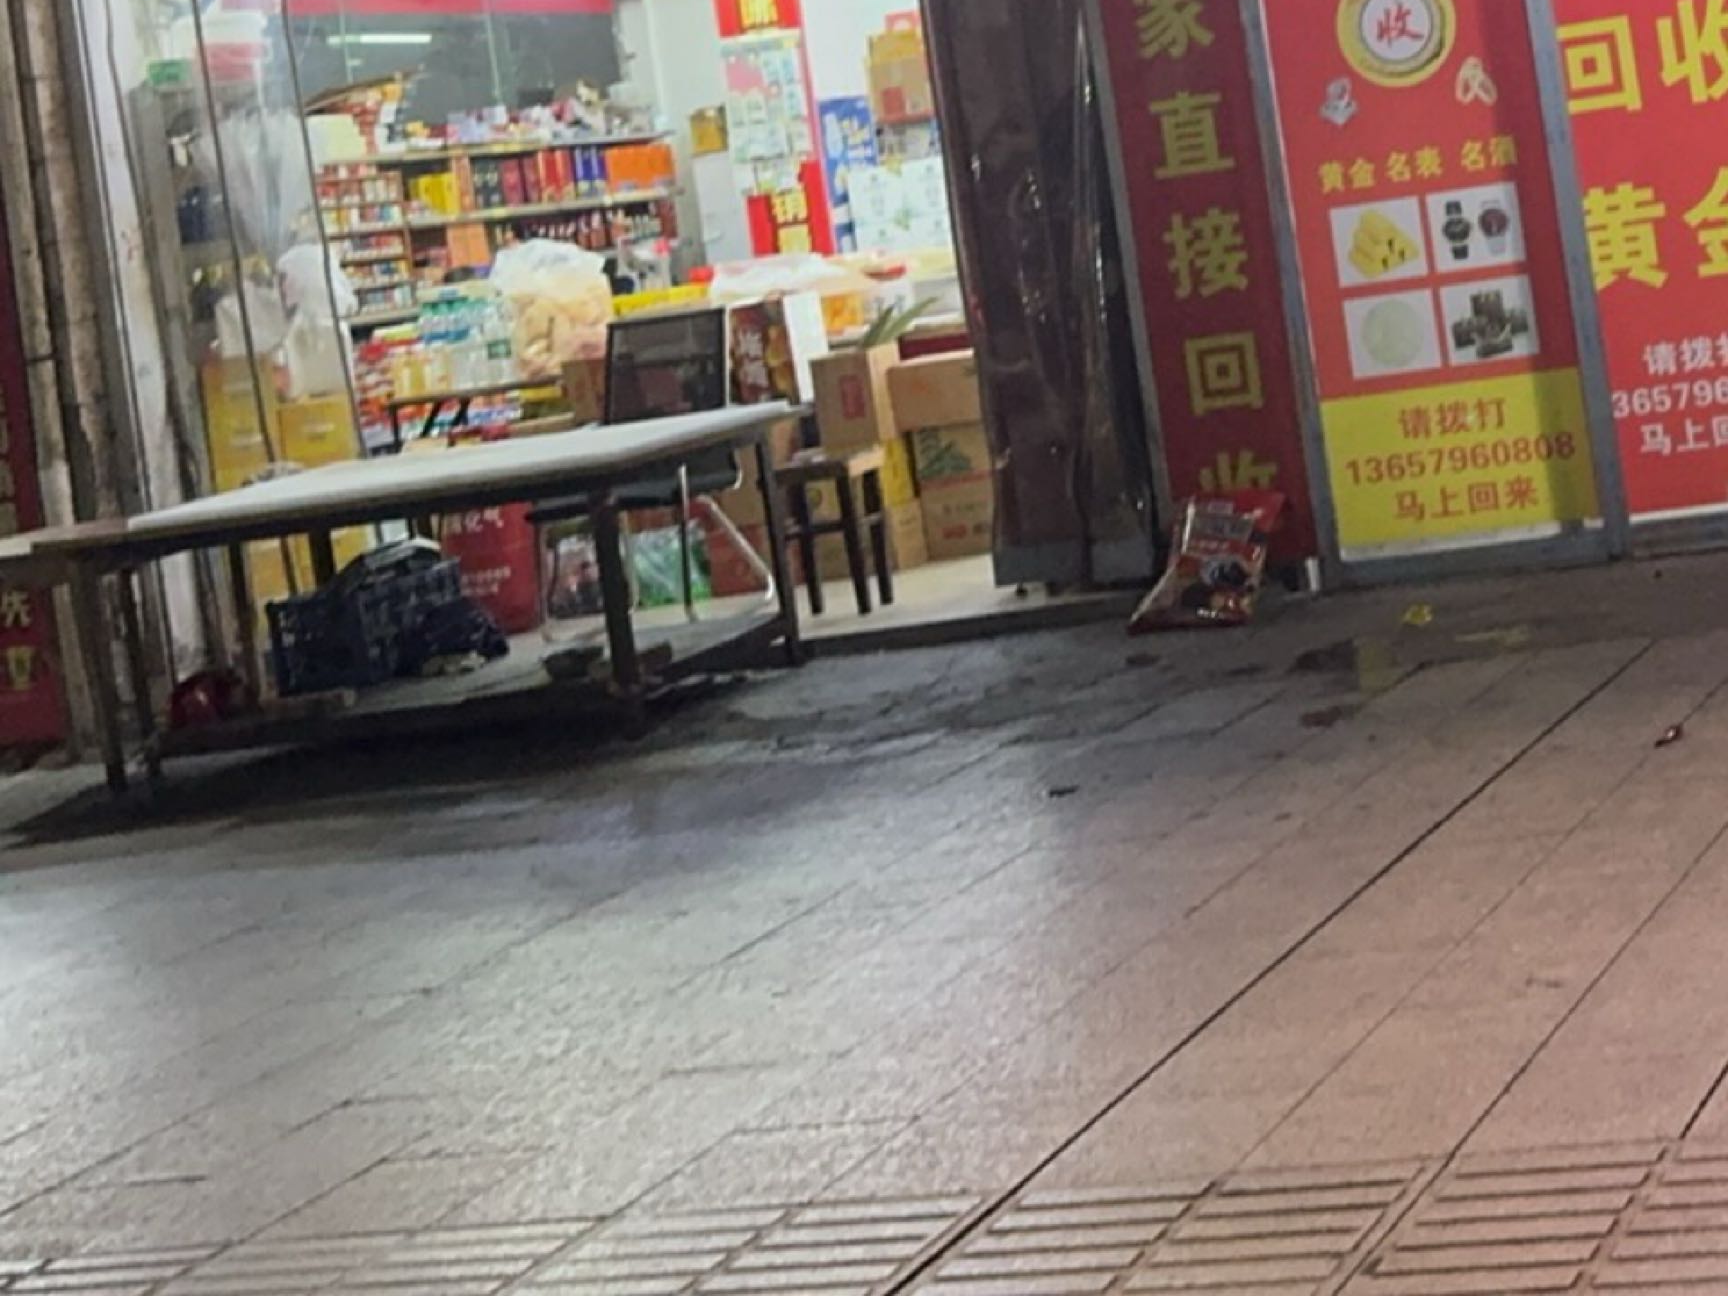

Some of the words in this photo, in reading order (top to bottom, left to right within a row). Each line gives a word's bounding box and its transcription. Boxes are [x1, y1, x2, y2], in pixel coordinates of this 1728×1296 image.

[1377, 1, 1424, 47] 收
[1319, 157, 1375, 194] 黄金
[1398, 398, 1507, 441] 请拨打
[1346, 432, 1576, 487] 13657960808
[1395, 475, 1539, 522] 马上回来
